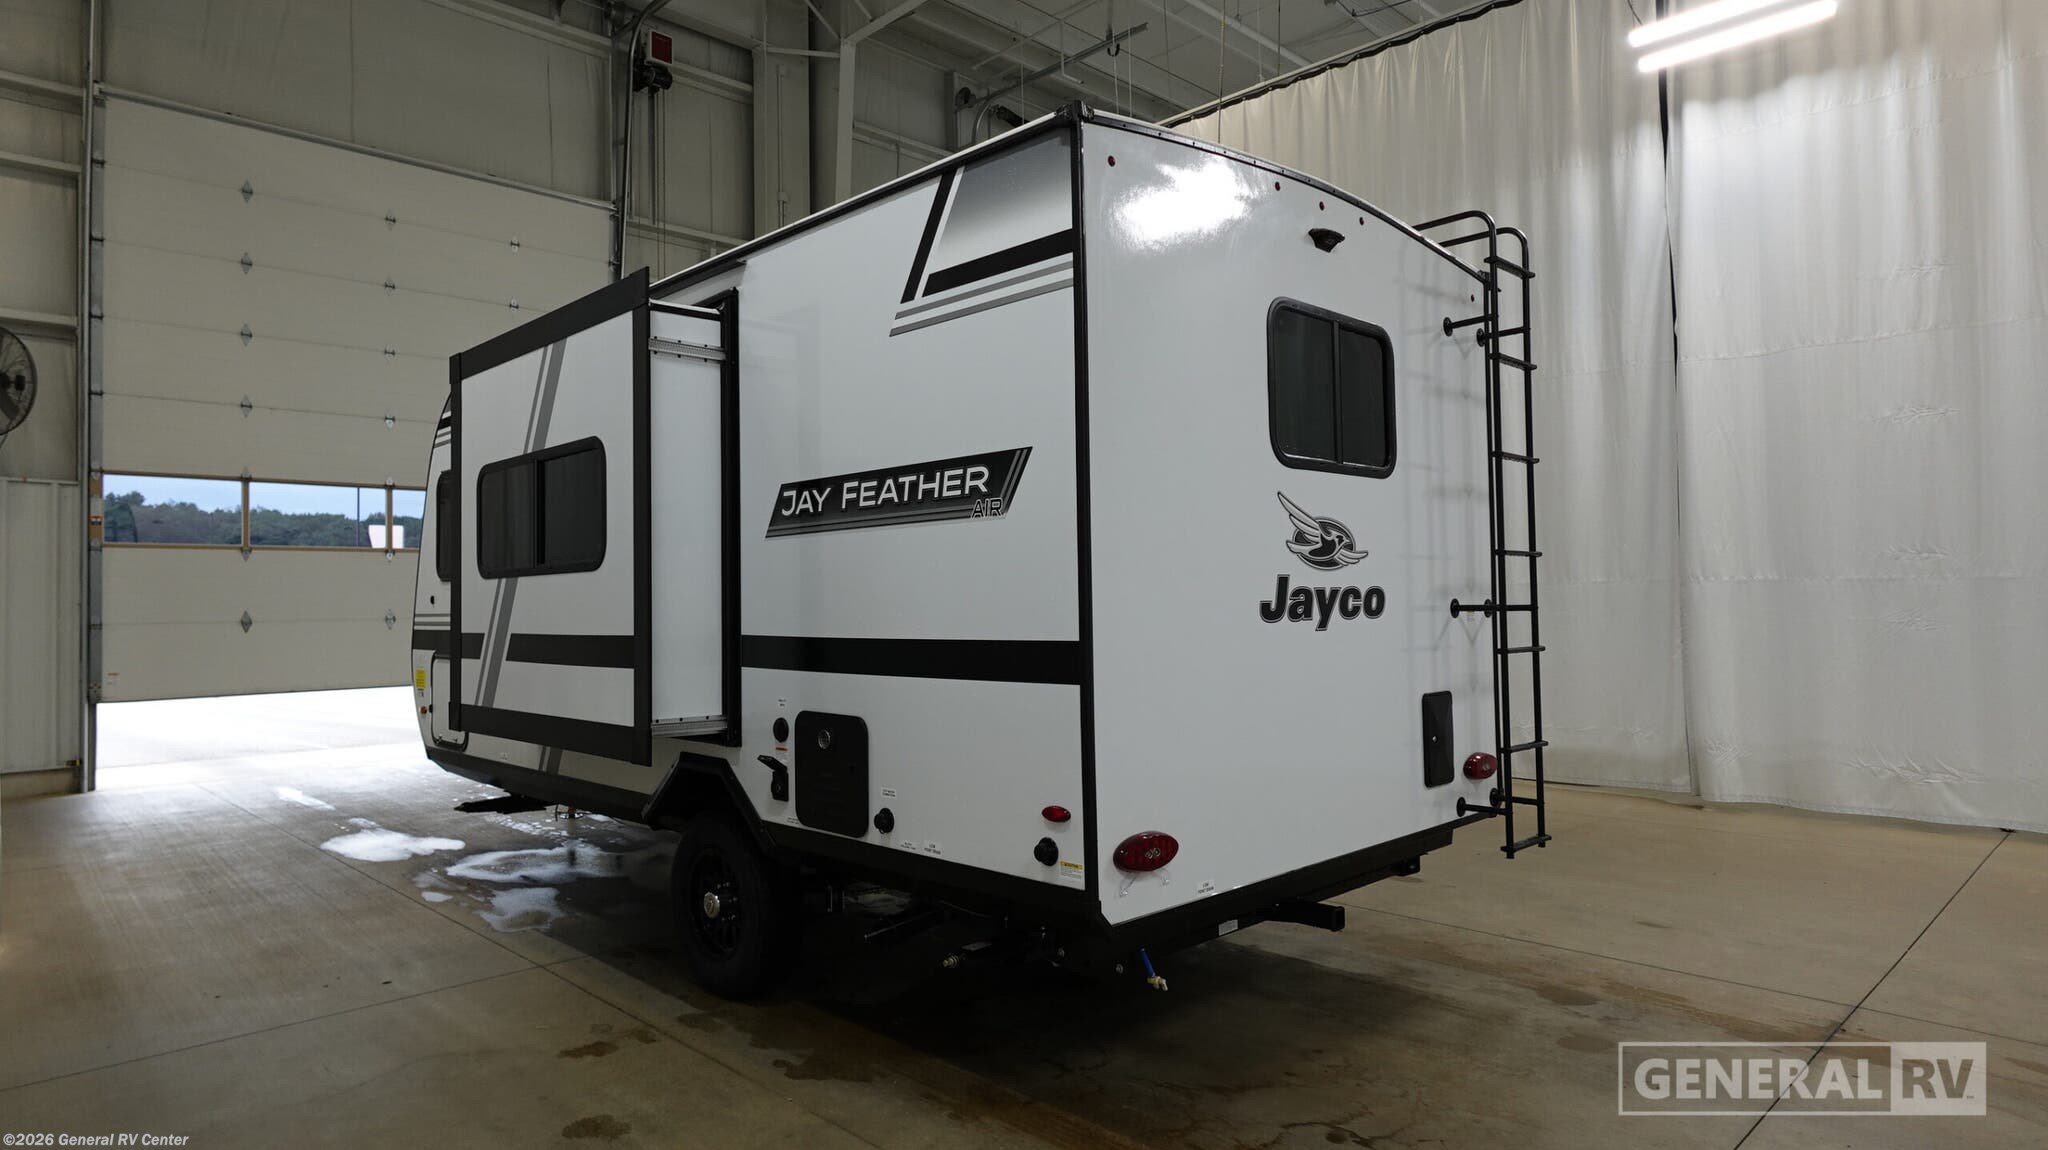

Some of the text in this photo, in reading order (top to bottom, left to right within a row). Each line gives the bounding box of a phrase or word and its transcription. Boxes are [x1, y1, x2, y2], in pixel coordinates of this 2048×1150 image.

[781, 466, 989, 516] JAY FEATHER
[970, 497, 1004, 519] AIR
[1259, 574, 1386, 631] Jayco
